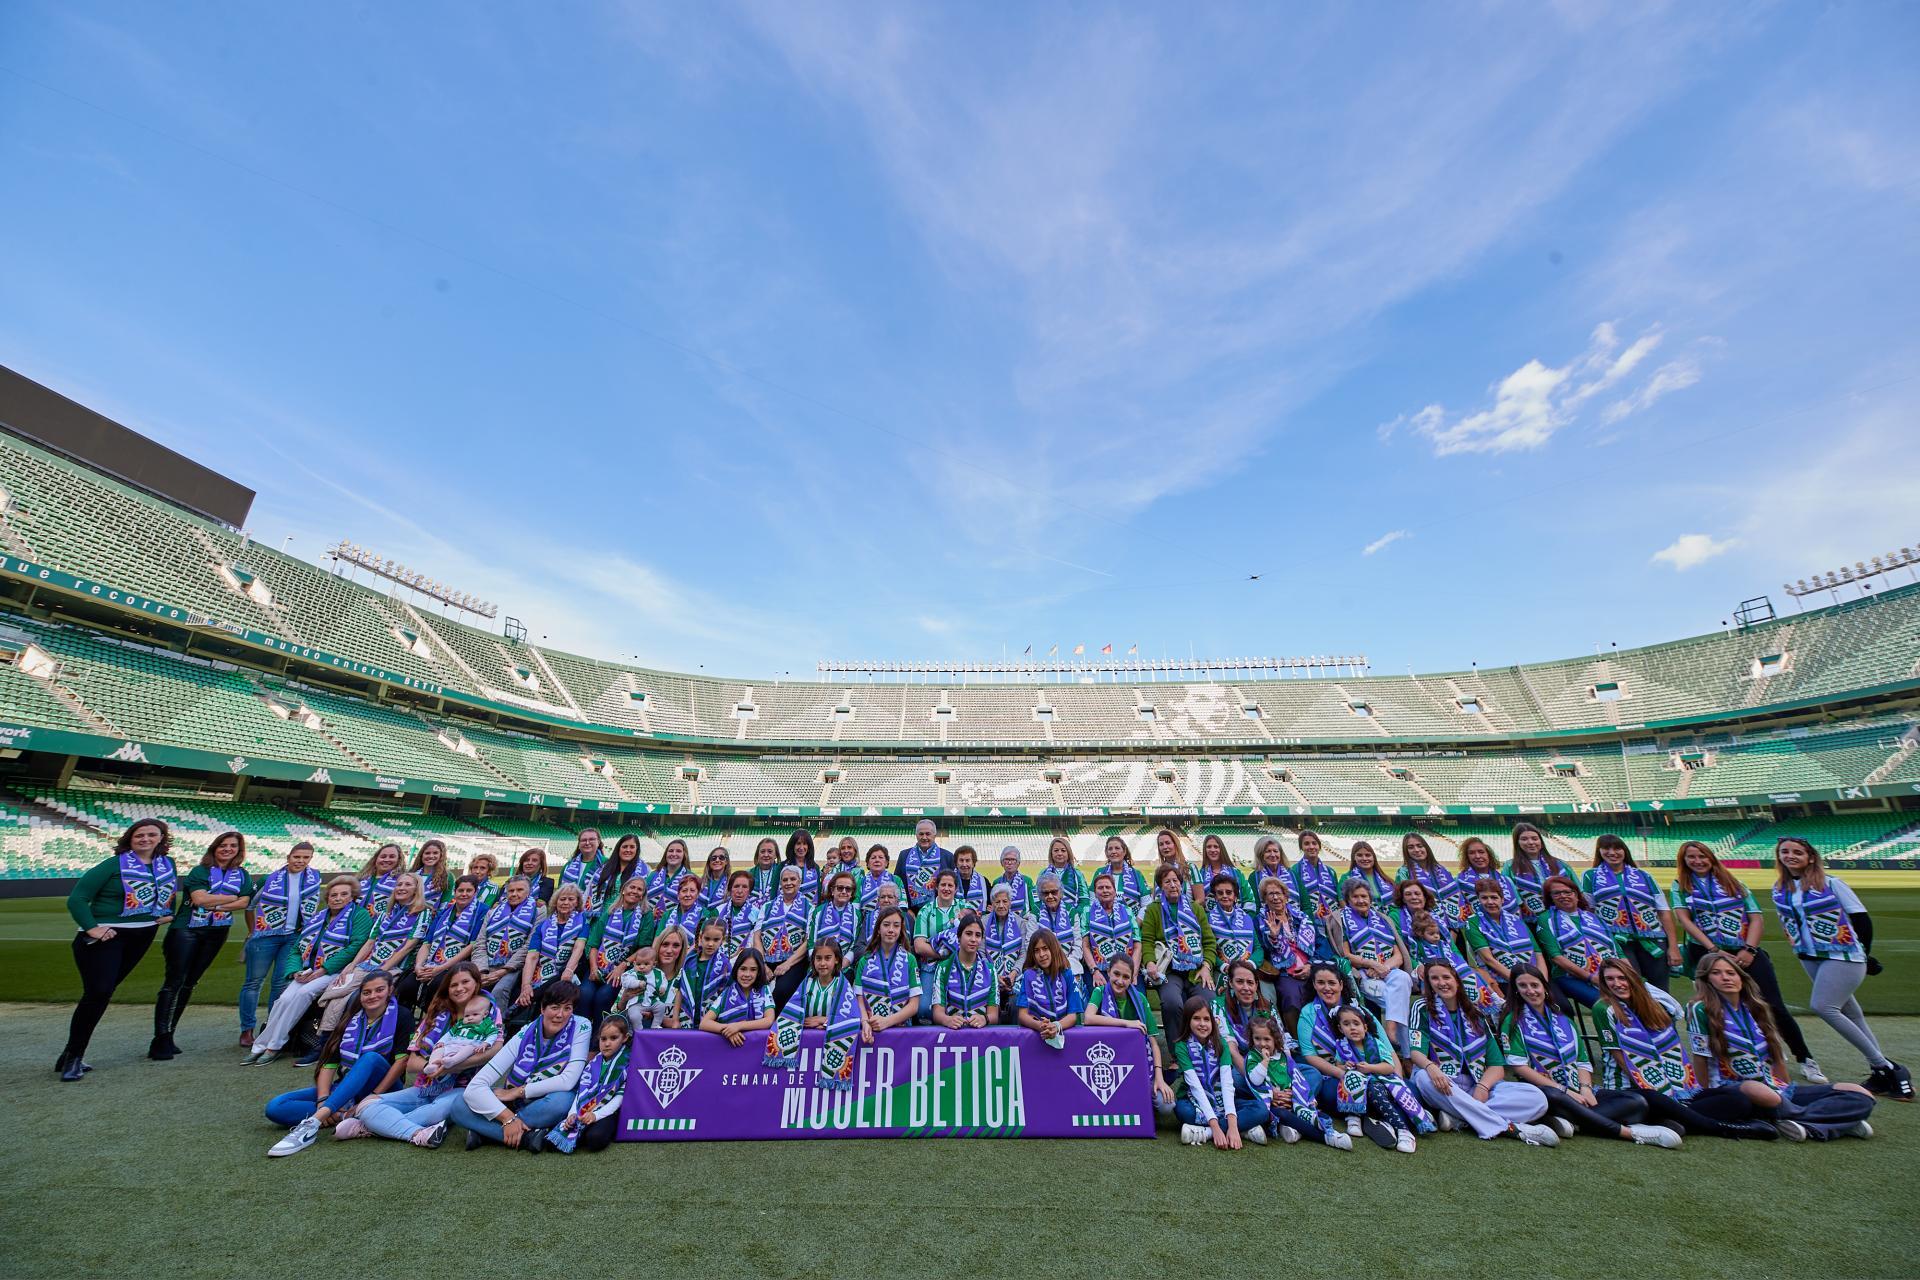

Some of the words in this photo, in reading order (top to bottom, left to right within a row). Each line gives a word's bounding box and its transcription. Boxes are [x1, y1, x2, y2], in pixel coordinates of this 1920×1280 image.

[74, 580, 179, 618] recorre
[264, 636, 320, 660] mundo
[333, 657, 391, 681] entero,
[404, 677, 443, 694] BETIS
[722, 1073, 779, 1086] SEMANA
[788, 1073, 805, 1085] DE
[909, 1032, 1026, 1128] BÉTICA
